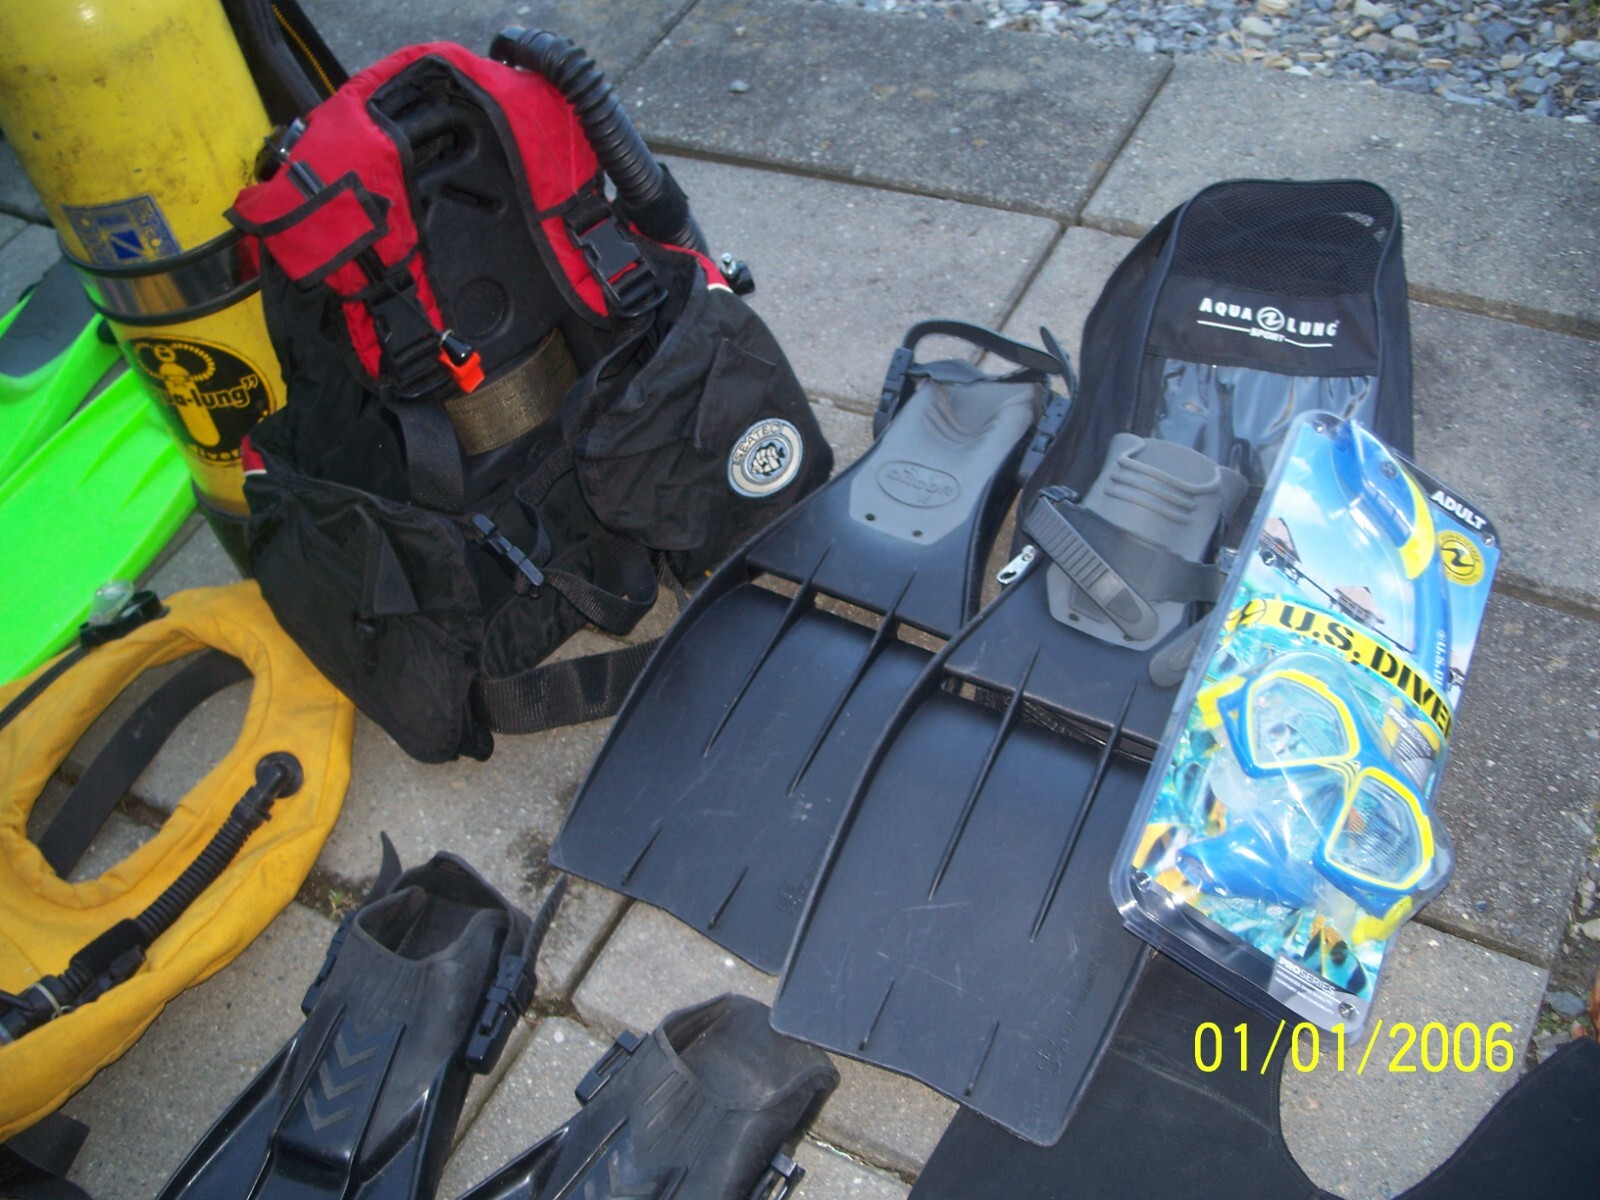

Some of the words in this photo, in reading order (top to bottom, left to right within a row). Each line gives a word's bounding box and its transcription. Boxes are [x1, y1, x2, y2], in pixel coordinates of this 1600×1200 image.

[1199, 297, 1252, 321] AQUA
[1285, 317, 1338, 337] LUNG
[1249, 327, 1287, 342] SPORT
[733, 422, 780, 464] SEATEC
[1431, 490, 1487, 530] ADULT
[1279, 605, 1361, 659] U.S.
